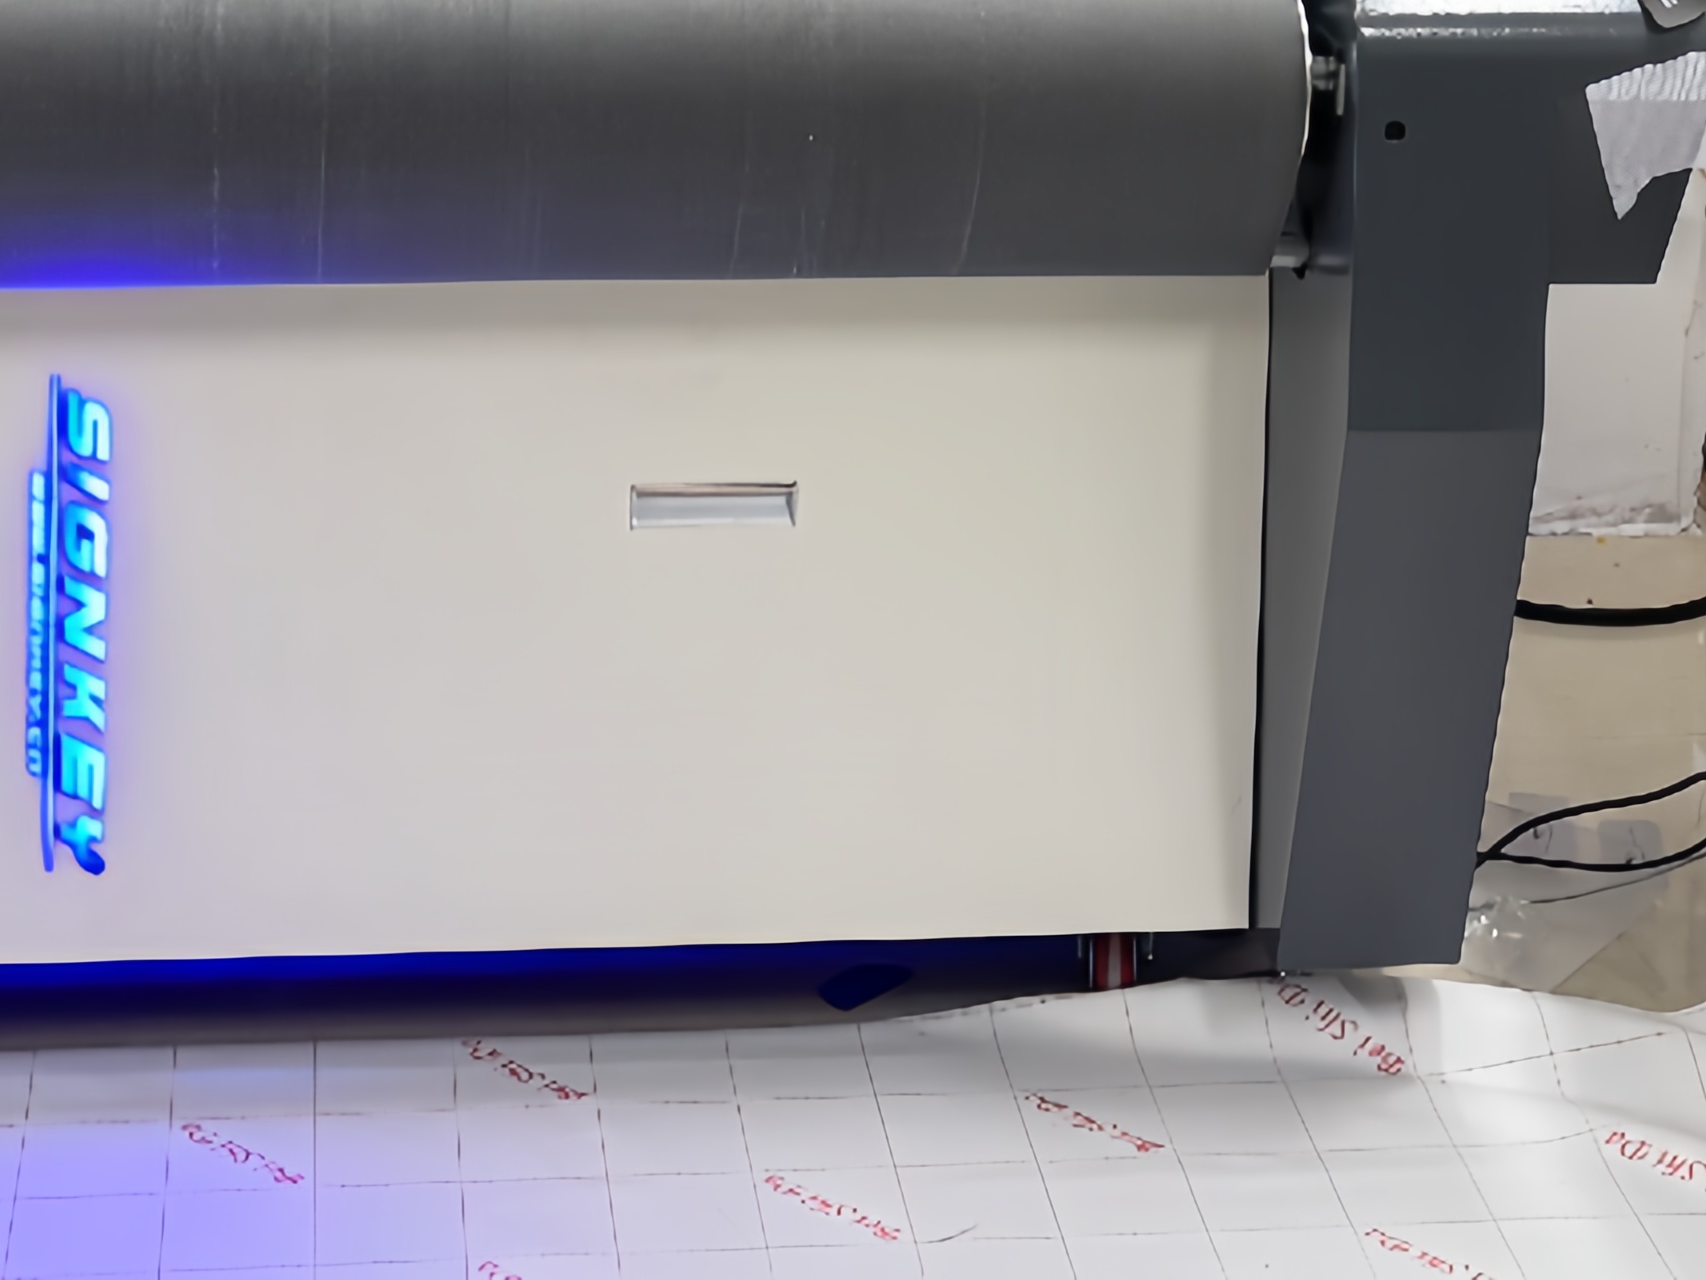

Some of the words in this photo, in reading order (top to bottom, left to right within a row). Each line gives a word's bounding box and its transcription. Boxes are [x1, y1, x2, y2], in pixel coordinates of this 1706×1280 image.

[60, 389, 112, 875] SIGNKEY
[1273, 981, 1309, 1007] D
[1305, 1000, 1359, 1040] Shi
[1353, 1036, 1405, 1075] Bei
[1605, 1131, 1652, 1160] Da
